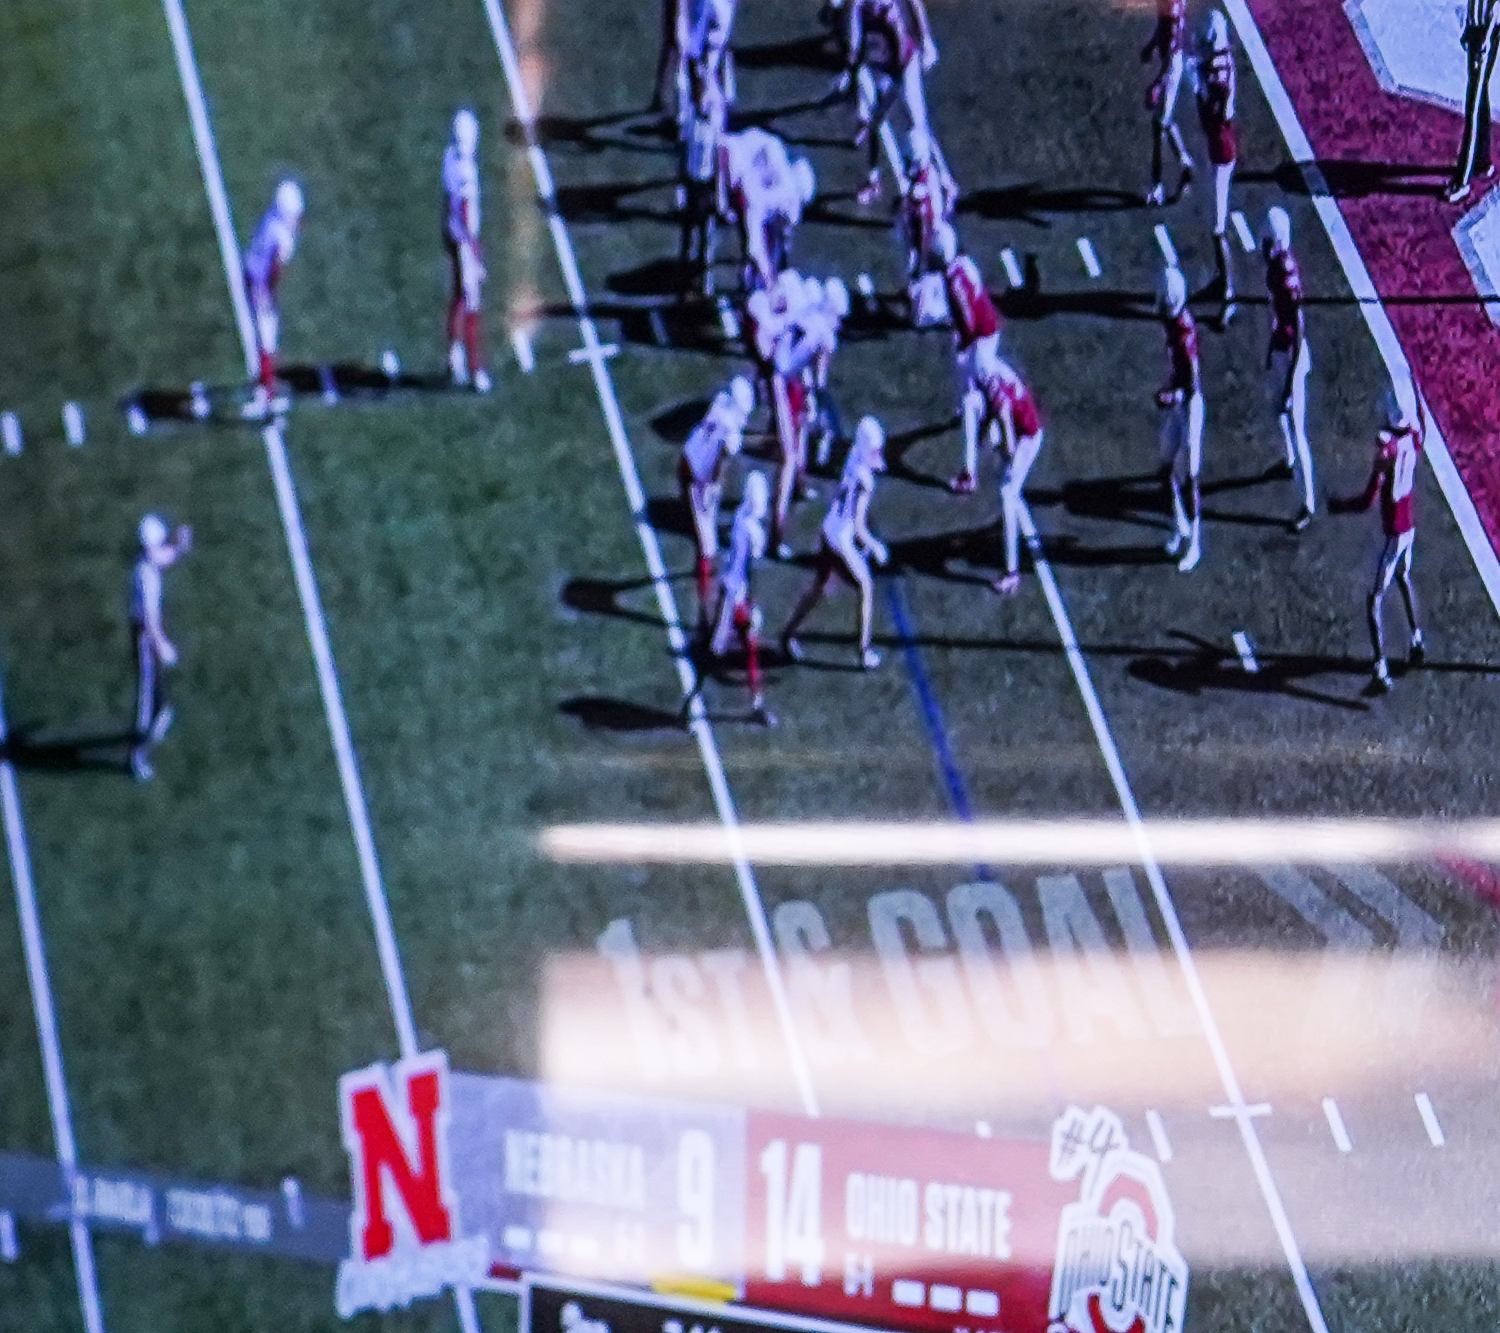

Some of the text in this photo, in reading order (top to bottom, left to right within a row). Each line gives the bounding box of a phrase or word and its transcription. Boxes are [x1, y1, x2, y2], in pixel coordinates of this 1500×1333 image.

[595, 917, 761, 1080] 1ST
[866, 867, 1200, 1057] GOAL
[348, 1066, 455, 1265] N
[676, 1129, 714, 1270] 9
[760, 1137, 825, 1287] 14
[846, 1173, 1012, 1260] OHIO STATE
